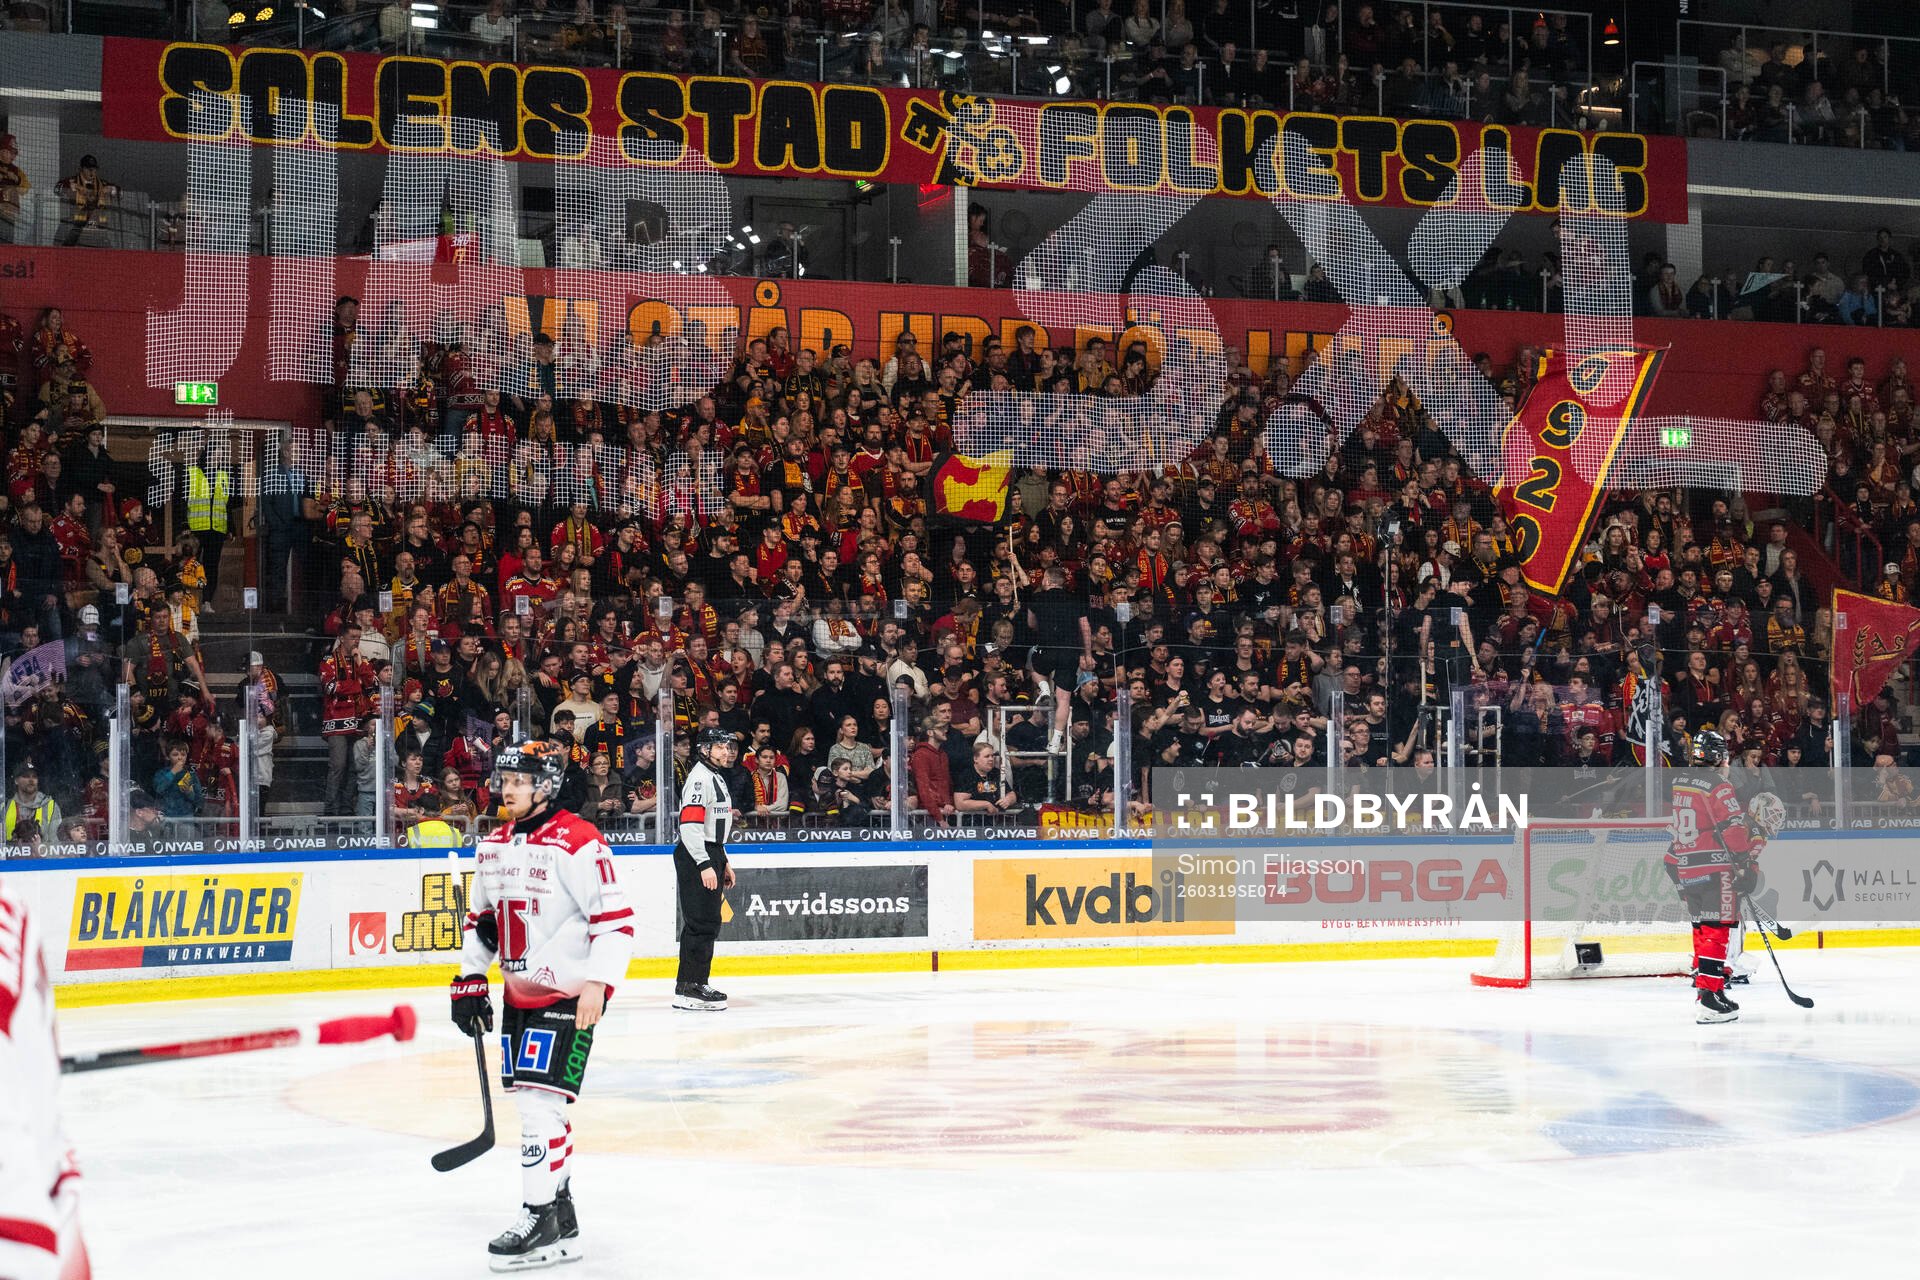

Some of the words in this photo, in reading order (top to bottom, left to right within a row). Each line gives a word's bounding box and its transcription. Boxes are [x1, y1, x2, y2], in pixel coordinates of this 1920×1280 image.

[158, 41, 594, 160] SOLENS
[616, 71, 891, 176] STAD
[1037, 101, 1461, 206] FOLKETS
[1479, 123, 1648, 218] LAG
[691, 794, 702, 803] 27
[1724, 797, 1741, 812] 39
[1787, 820, 1821, 829] NYAB
[1888, 818, 1920, 828] NYAB
[603, 831, 646, 842] NYAB
[745, 831, 787, 841] NYAB
[811, 830, 852, 840] NYAB
[873, 830, 913, 839] NYAB
[937, 829, 977, 838] NYAB
[997, 828, 1037, 838] NYAB
[1060, 828, 1099, 838] NYAB
[1118, 828, 1157, 837] NYAB
[166, 841, 204, 852] NYAB
[226, 839, 266, 850] NYAB
[286, 838, 326, 848] NYAB
[350, 836, 391, 847] NYAB
[50, 844, 87, 855] NYAB
[109, 843, 146, 853] NYAB
[1264, 858, 1509, 905] BORGA
[1853, 869, 1917, 886] WALL
[1026, 869, 1185, 926] kvdbil
[1854, 892, 1911, 902] SECURITY
[745, 892, 910, 916] Arvidssons
[78, 878, 292, 942] BLÅKLÄDER
[1356, 915, 1463, 929] BEKYMMERSFRITT
[168, 945, 266, 961] WORKWEAR
